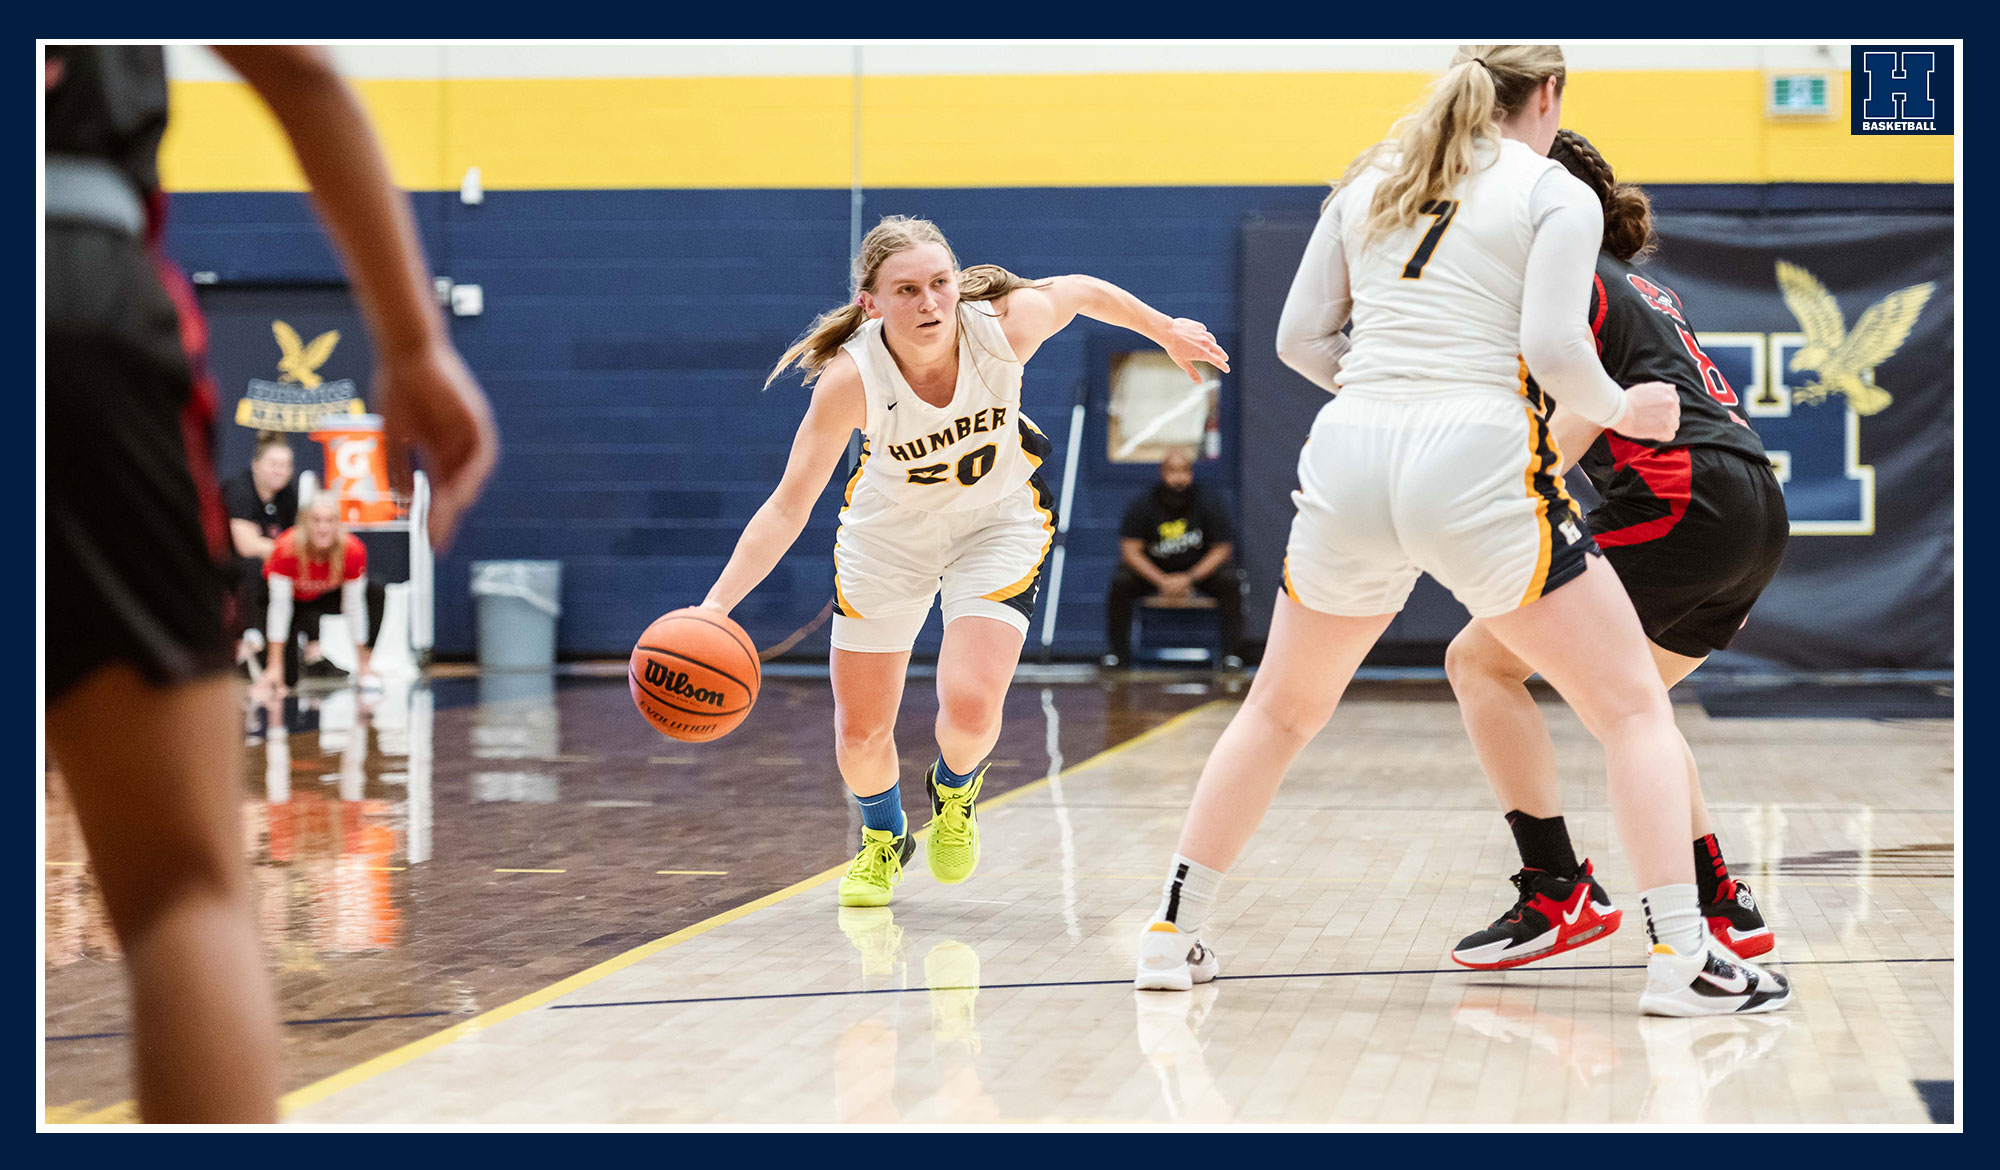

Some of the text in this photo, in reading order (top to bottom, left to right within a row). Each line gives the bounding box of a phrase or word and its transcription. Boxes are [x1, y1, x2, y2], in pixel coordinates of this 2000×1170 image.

[1399, 199, 1460, 280] 7
[1674, 323, 1739, 406] 8
[888, 407, 1007, 461] HUMBER
[336, 439, 372, 479] G
[905, 442, 999, 488] 20
[644, 658, 725, 707] Wilson
[639, 699, 718, 734] EVOLUTION
